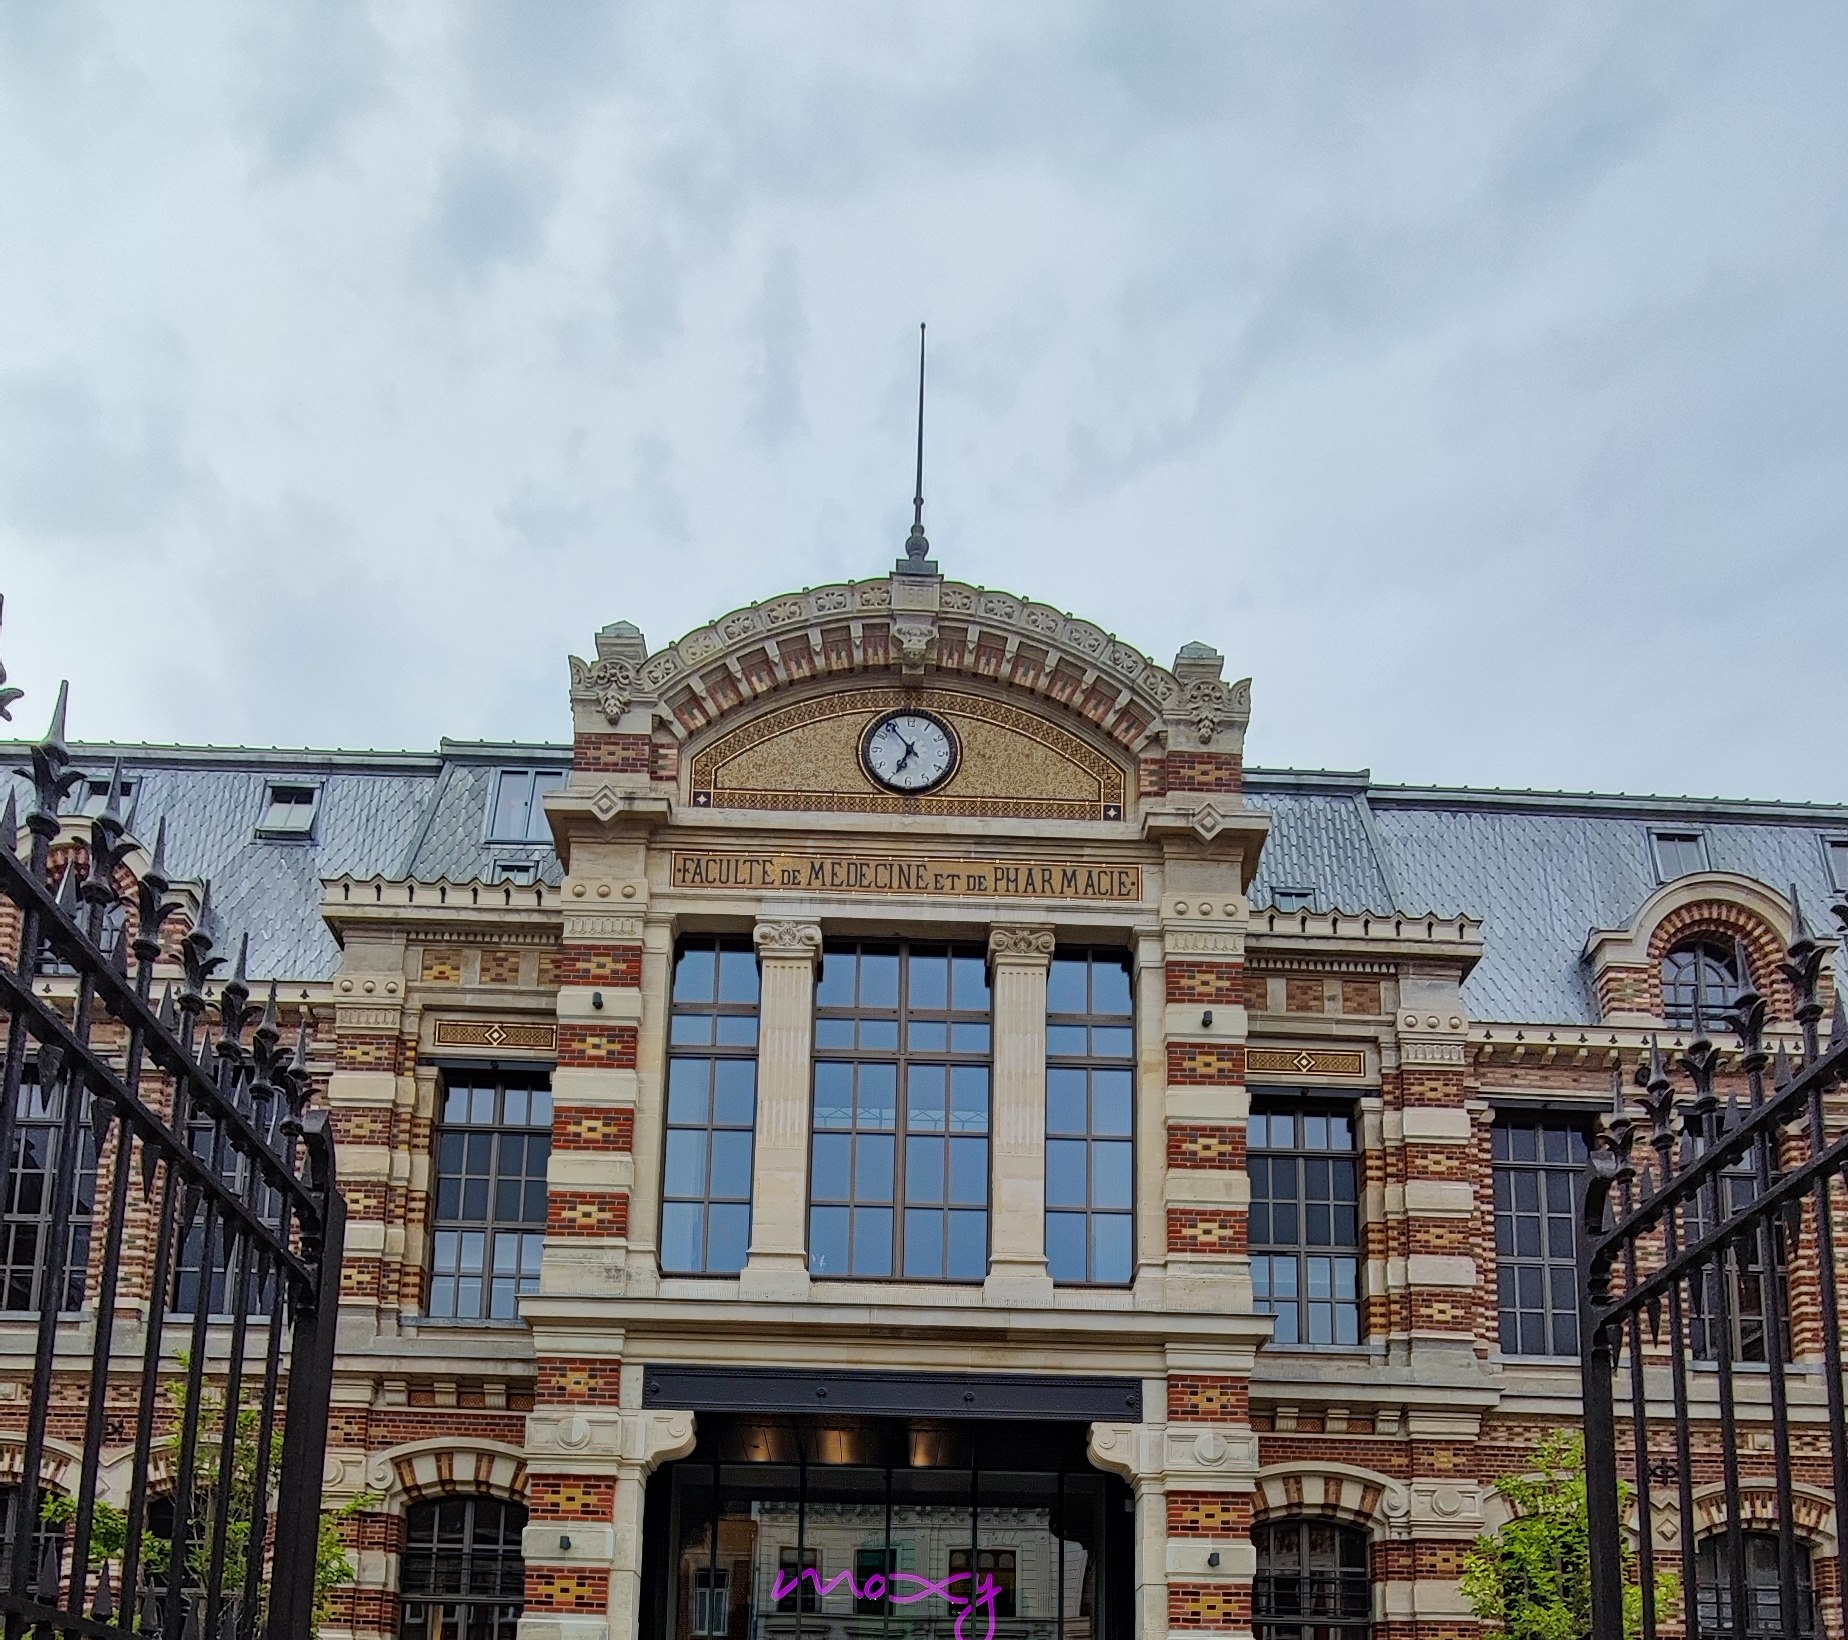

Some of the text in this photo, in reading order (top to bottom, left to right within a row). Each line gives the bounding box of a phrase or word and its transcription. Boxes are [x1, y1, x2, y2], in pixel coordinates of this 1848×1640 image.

[907, 717, 916, 728] 12
[876, 730, 888, 741] 10
[937, 750, 948, 758] 3
[875, 761, 886, 770] 8
[933, 763, 943, 773] 4
[904, 776, 912, 788] 6
[921, 773, 930, 783] 5
[780, 869, 801, 886] DE
[933, 873, 961, 891] ET
[965, 874, 987, 892] DE
[993, 866, 1132, 896] PHARMACIE
